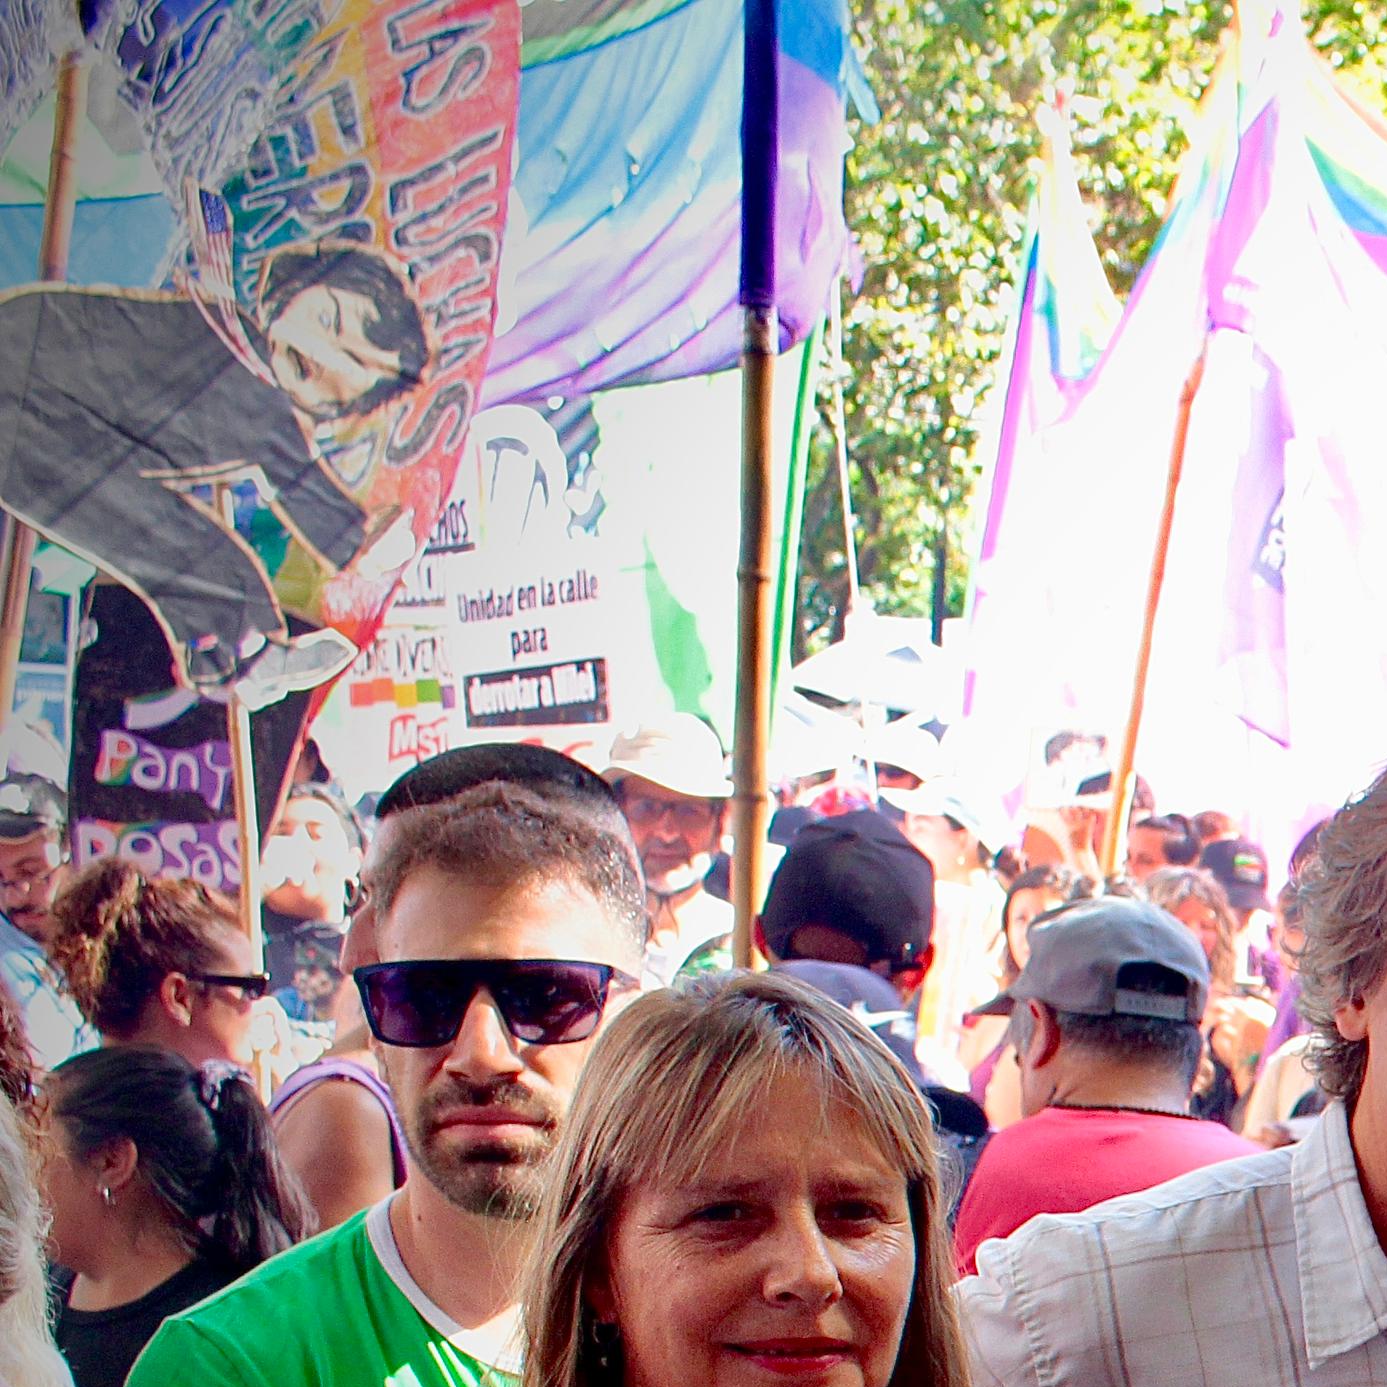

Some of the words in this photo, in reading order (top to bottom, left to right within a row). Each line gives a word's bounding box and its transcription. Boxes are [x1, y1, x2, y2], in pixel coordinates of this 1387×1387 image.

[457, 585, 514, 623] Unidad
[518, 585, 537, 610] en
[541, 576, 556, 607] la
[559, 569, 599, 603] calle
[510, 627, 548, 661] para
